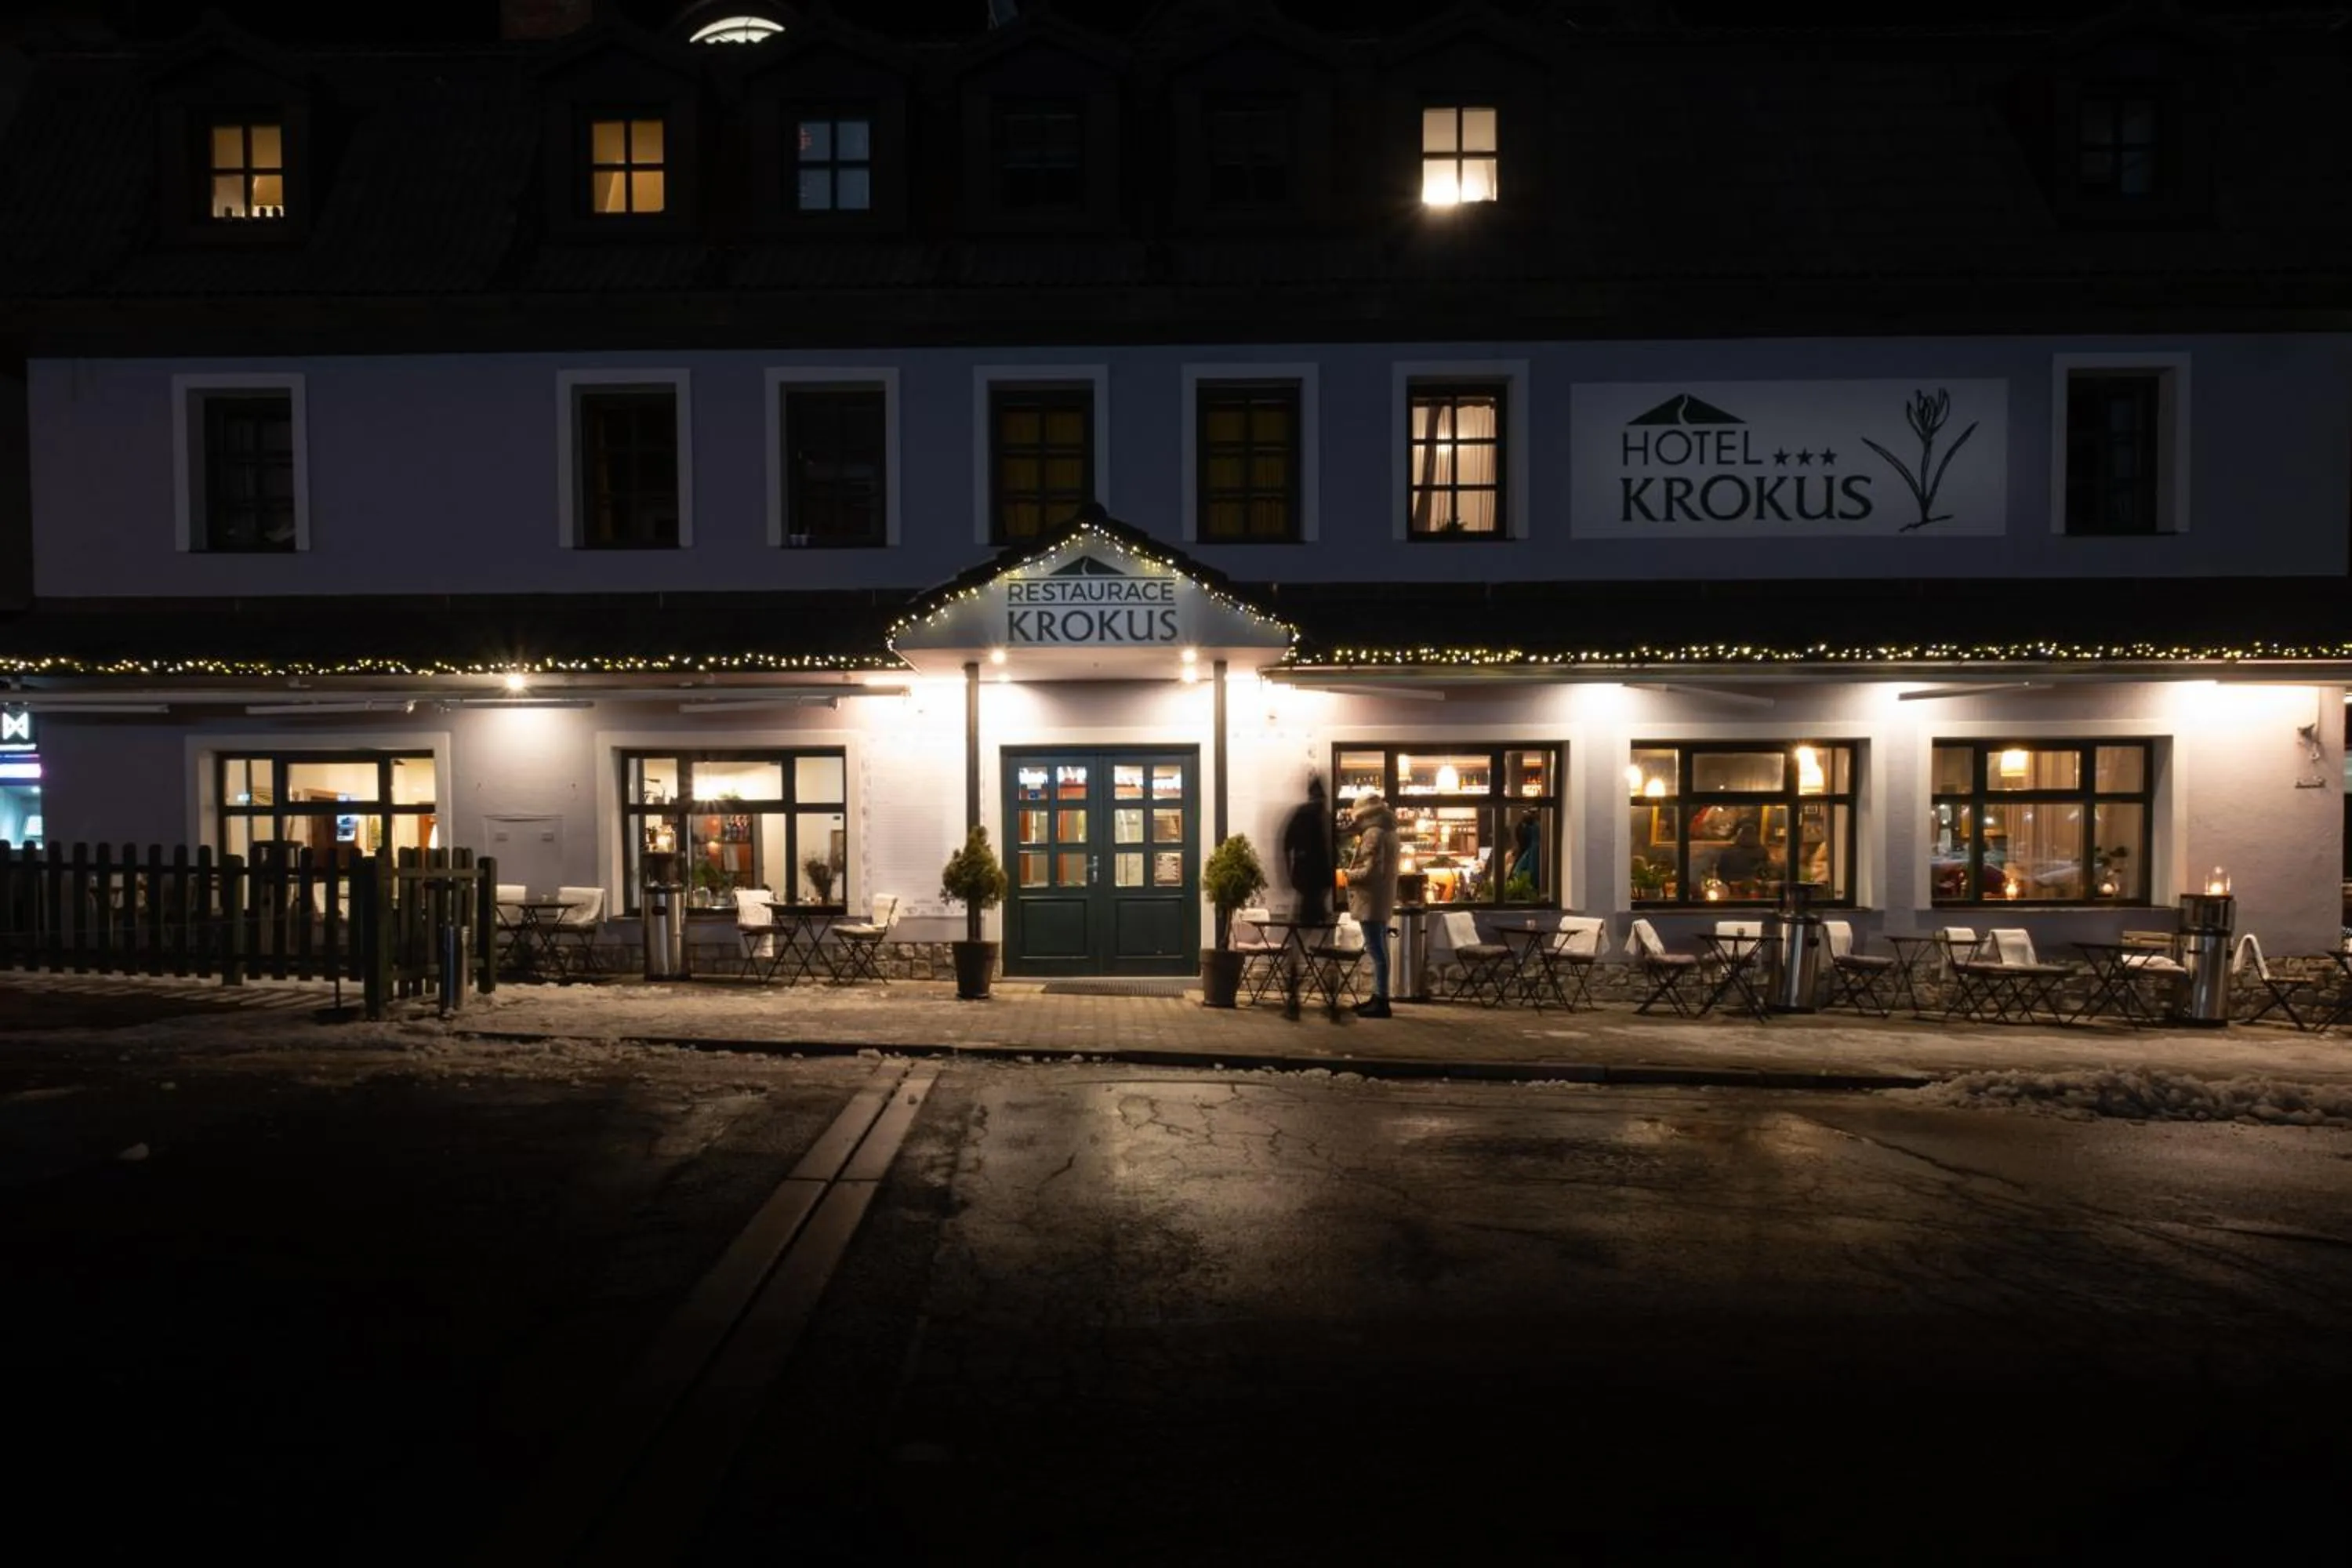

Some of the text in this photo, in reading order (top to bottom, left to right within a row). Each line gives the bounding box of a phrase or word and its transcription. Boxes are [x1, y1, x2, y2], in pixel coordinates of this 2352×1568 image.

[1622, 429, 1763, 466] HOTEL
[1620, 474, 1873, 522] KROKUS
[1007, 582, 1175, 601] RESTAURACE
[1007, 609, 1178, 642] KROKUS
